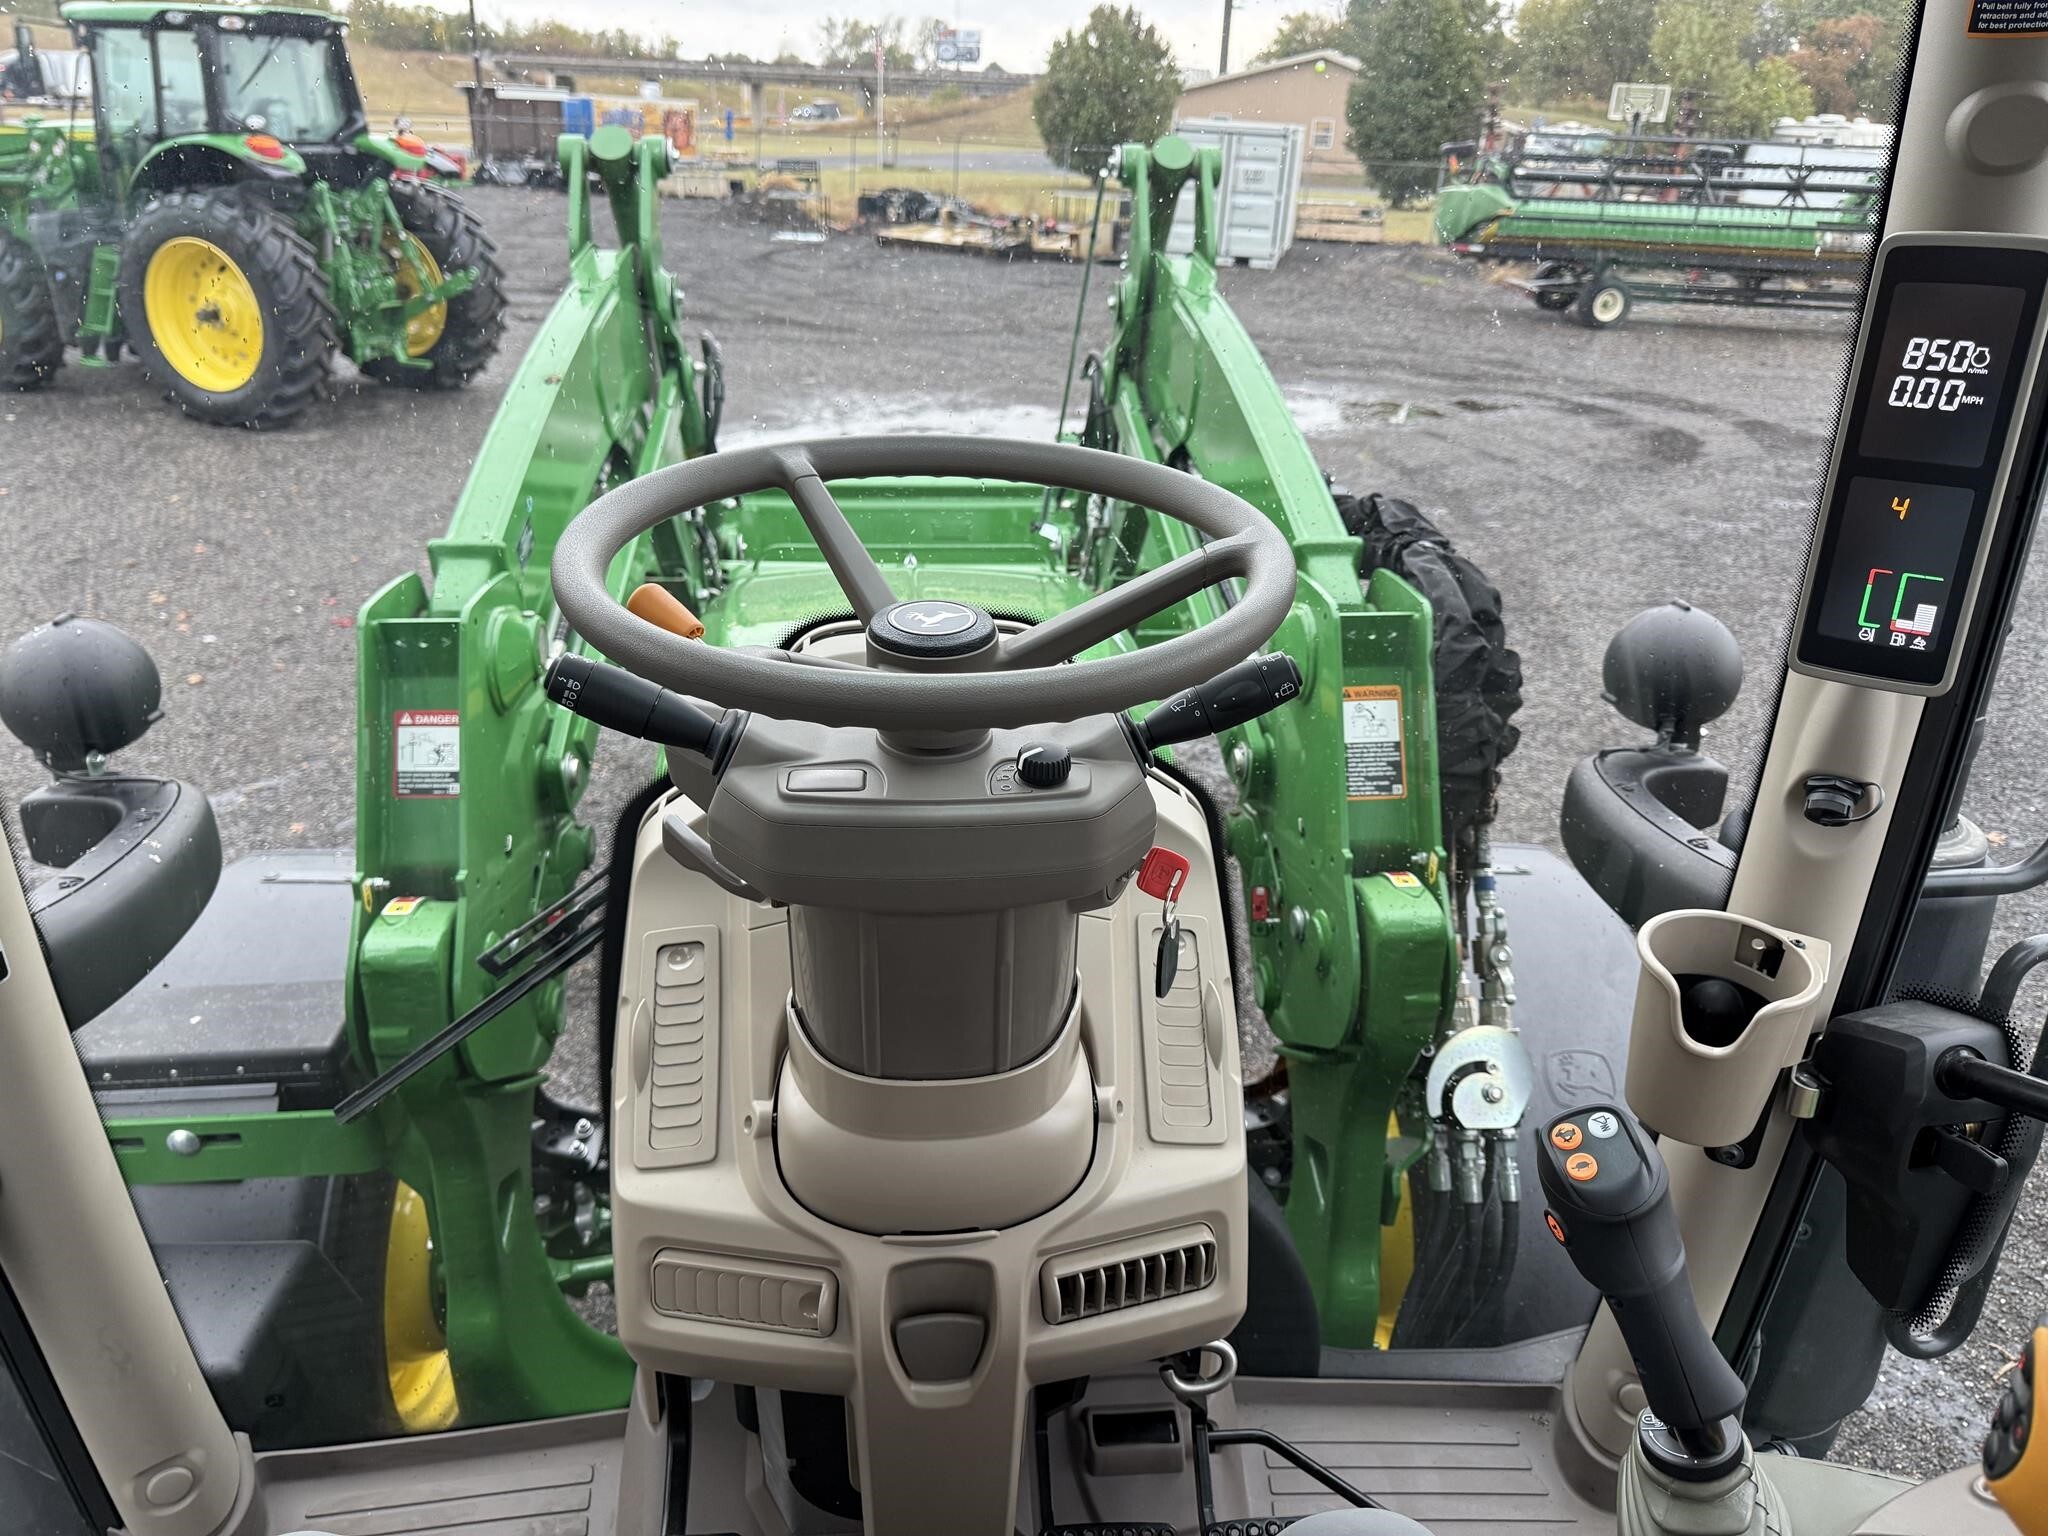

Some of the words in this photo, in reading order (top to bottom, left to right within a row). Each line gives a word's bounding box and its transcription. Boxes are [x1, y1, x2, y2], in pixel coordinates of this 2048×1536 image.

[1981, 2, 1996, 10] Pull
[1996, 2, 2012, 10] belt
[2014, 2, 2032, 11] fully
[1980, 12, 2018, 20] retractors
[2019, 11, 2036, 19] and
[1978, 21, 1988, 29] for
[1989, 21, 2008, 29] best
[1902, 337, 1976, 373] 850
[1888, 375, 1966, 412] 0.00
[1961, 394, 1984, 405] MPH
[1891, 496, 1910, 520] 4
[1353, 688, 1398, 698] WARNING
[415, 714, 460, 725] DANGER
